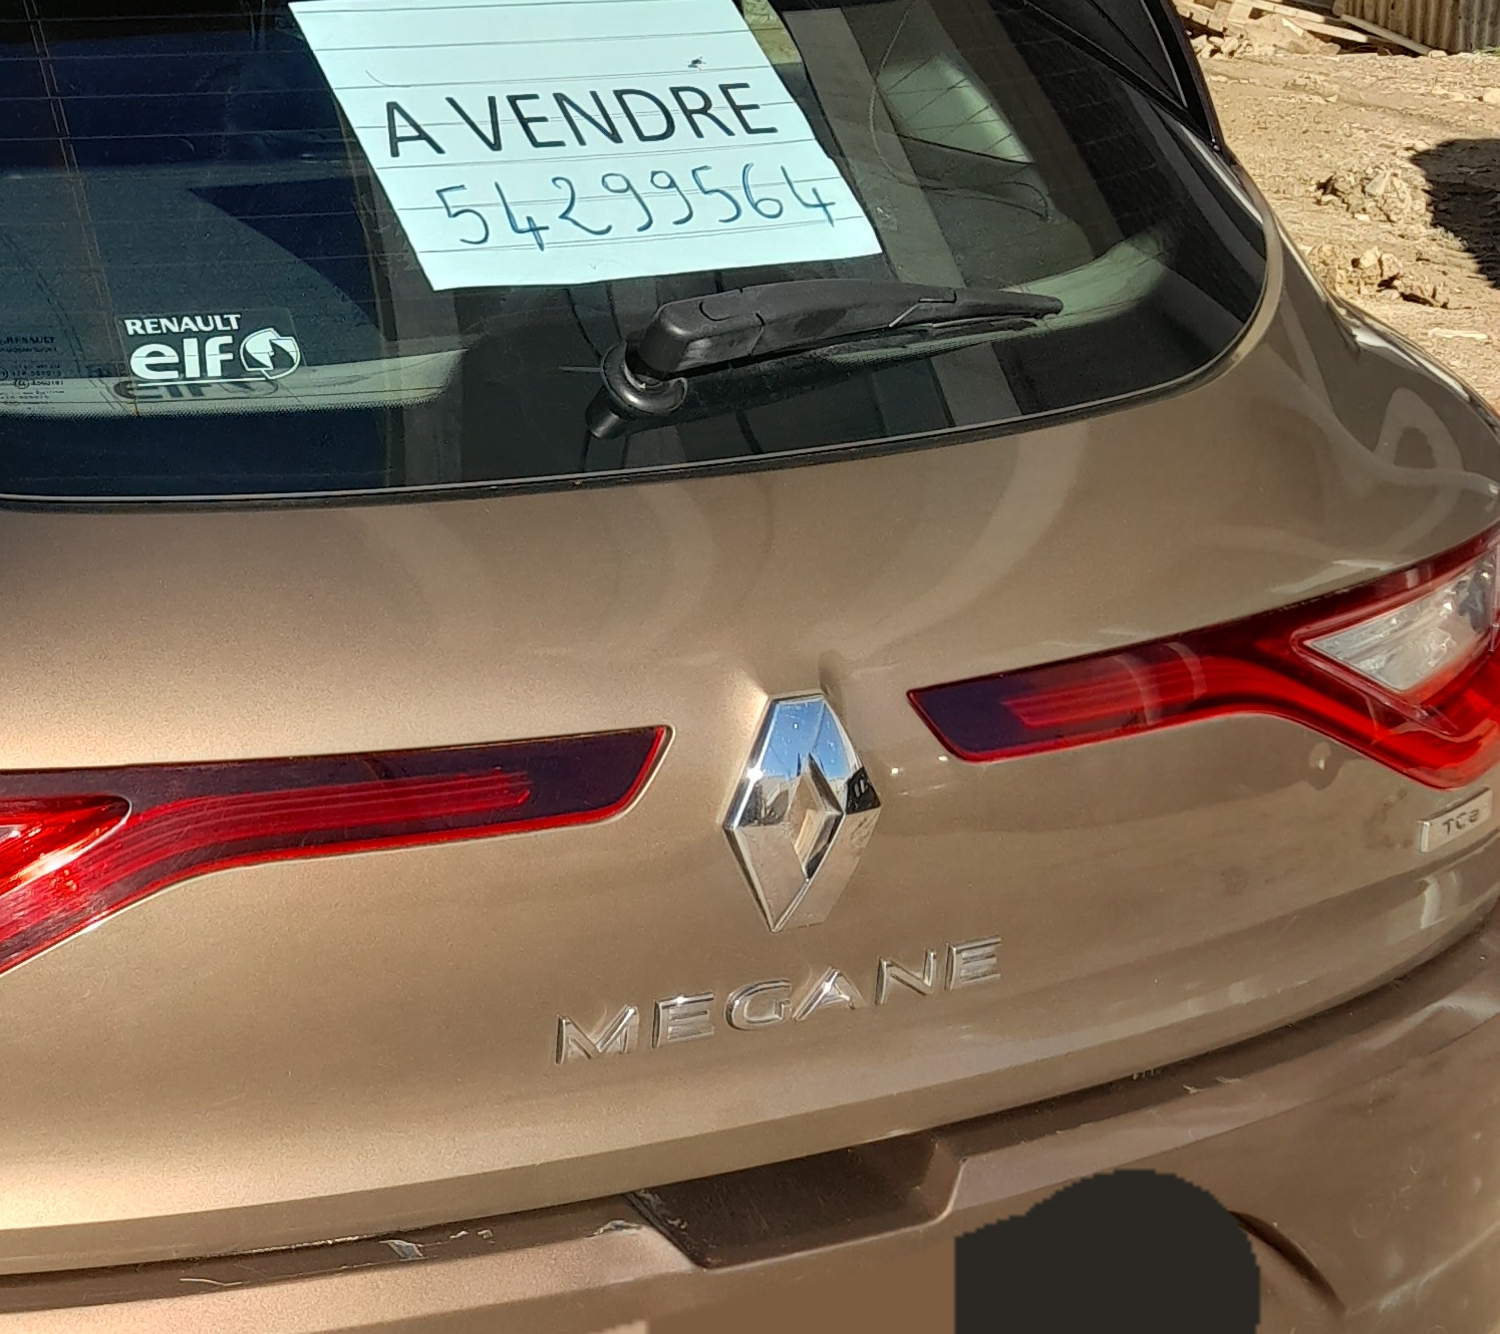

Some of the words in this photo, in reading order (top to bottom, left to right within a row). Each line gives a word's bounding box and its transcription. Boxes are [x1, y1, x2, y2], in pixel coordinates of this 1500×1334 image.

[385, 100, 446, 157] A
[445, 82, 779, 152] VENDRE
[434, 162, 837, 251] 54299564
[124, 314, 242, 336] RENAULT
[130, 335, 234, 381] elf
[555, 934, 1002, 1065] MEGANE
